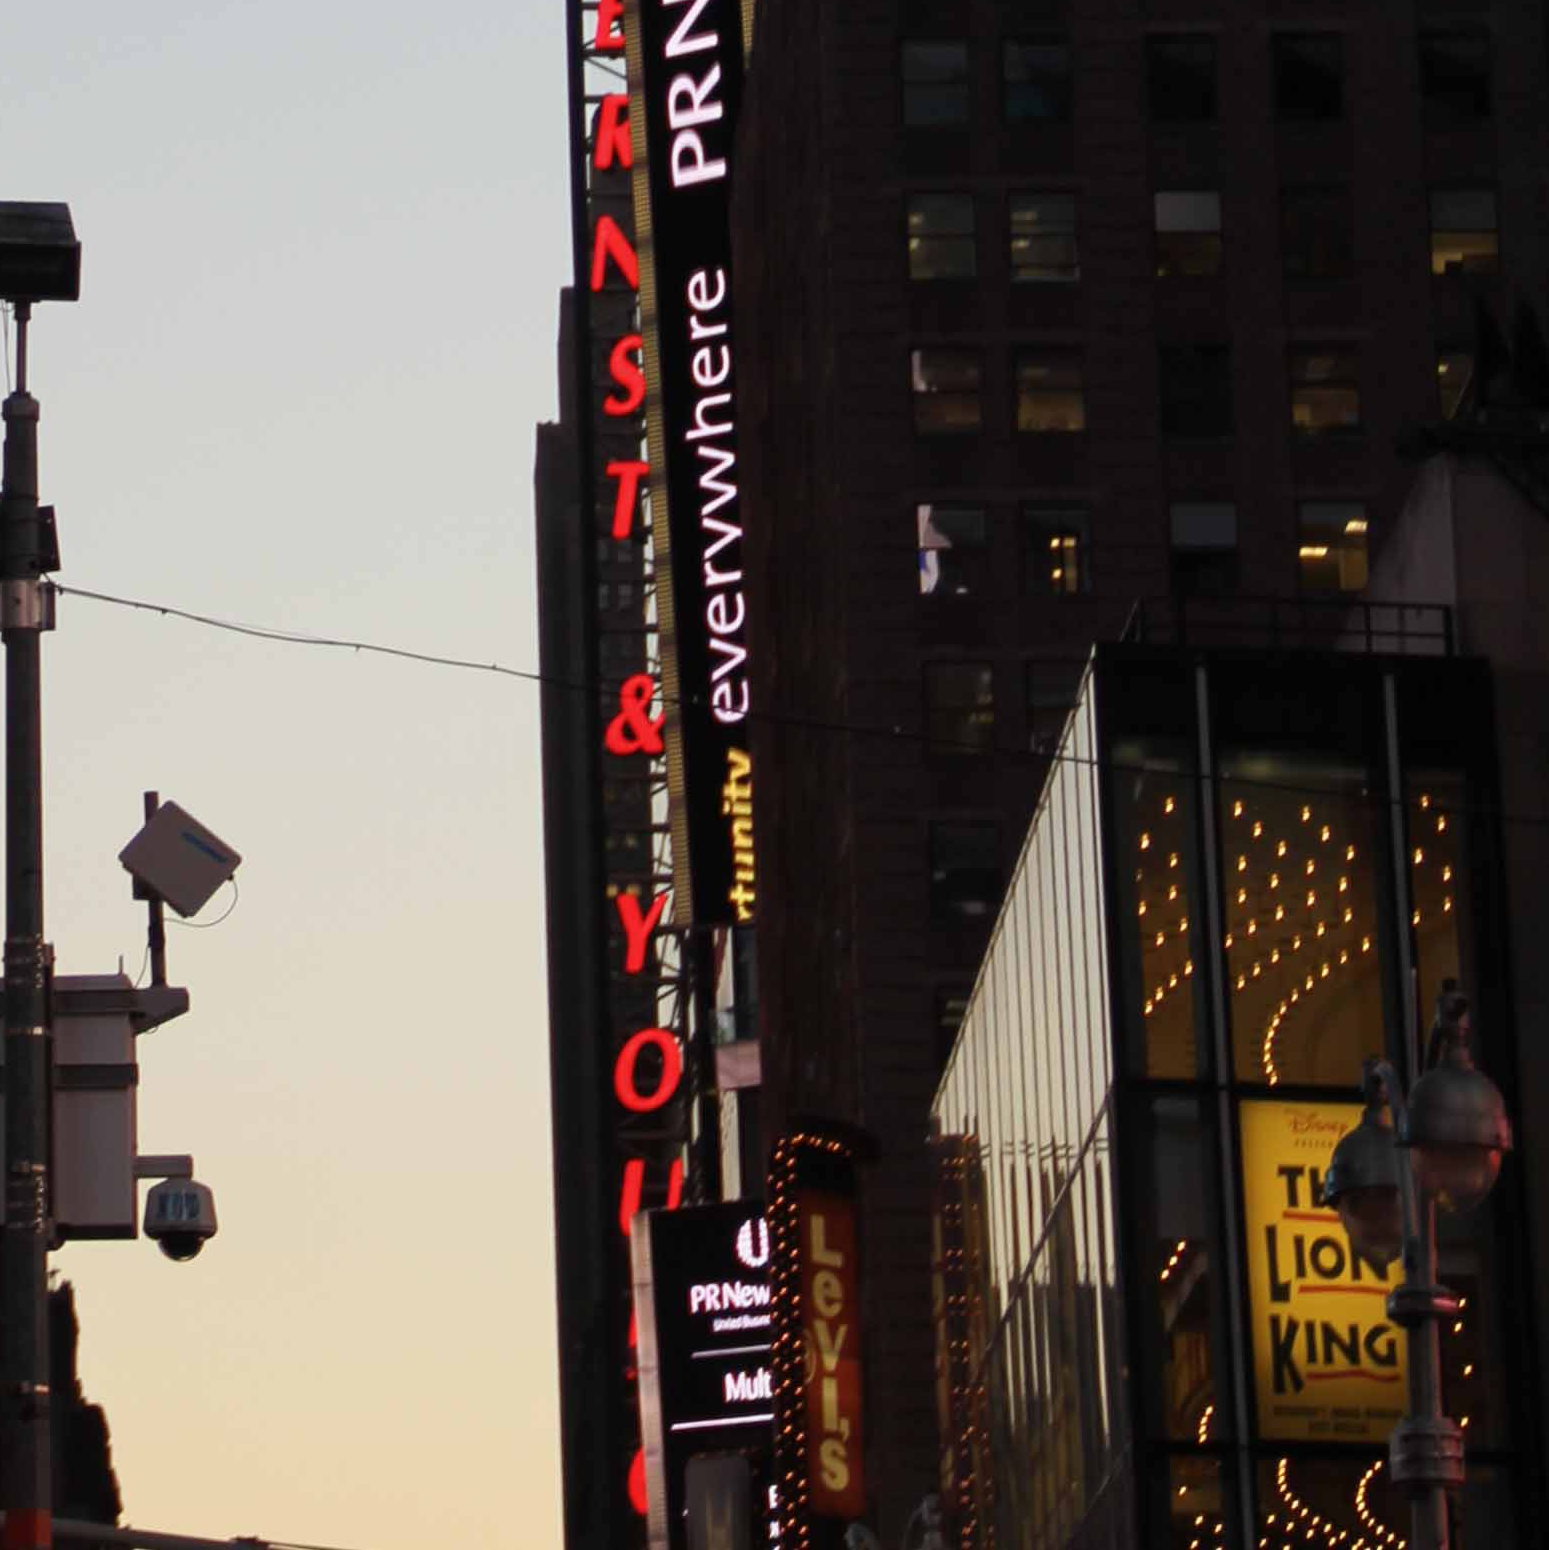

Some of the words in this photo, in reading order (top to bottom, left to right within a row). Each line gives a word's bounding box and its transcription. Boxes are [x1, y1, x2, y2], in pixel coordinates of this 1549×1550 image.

[684, 268, 750, 725] everywhere
[606, 674, 666, 755] &
[1268, 1313, 1398, 1395] KING
